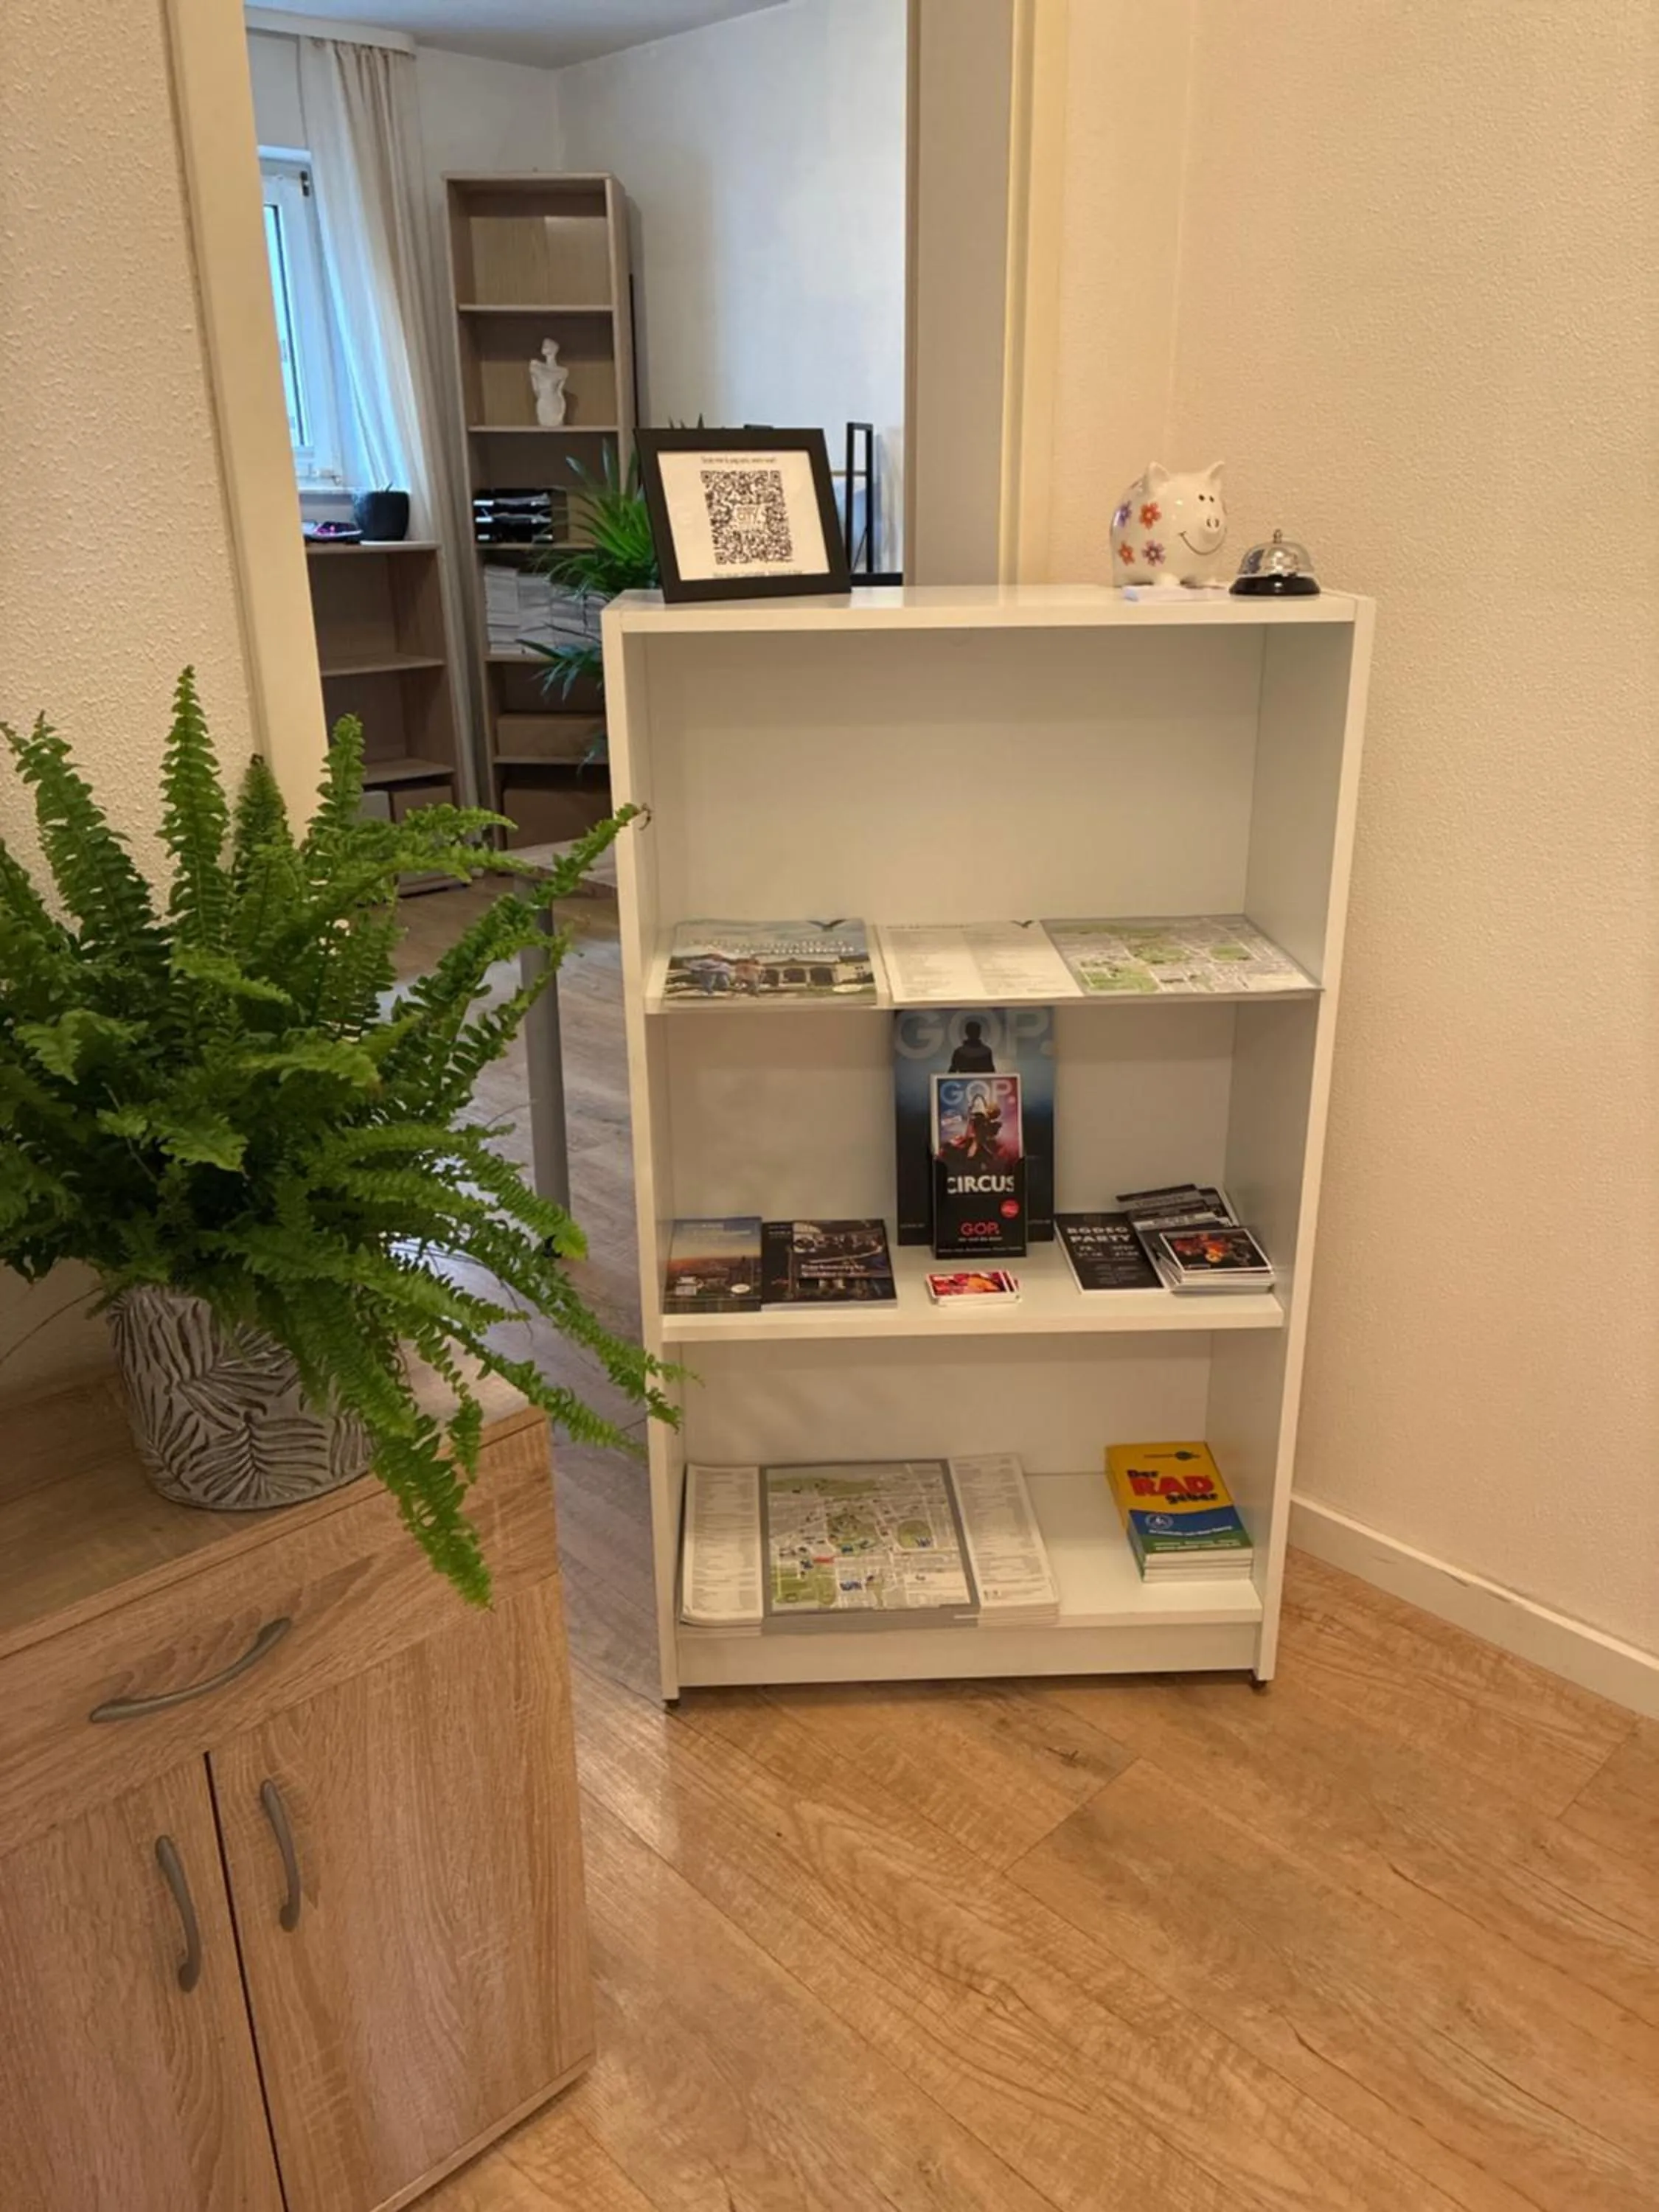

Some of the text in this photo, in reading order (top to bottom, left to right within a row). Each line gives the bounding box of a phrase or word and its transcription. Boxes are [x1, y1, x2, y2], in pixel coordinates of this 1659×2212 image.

[947, 1175, 1015, 1194] CIRCUS
[960, 1222, 1001, 1237] GOP.
[1070, 1234, 1130, 1243] PARTY
[1130, 1475, 1214, 1497] RAD
